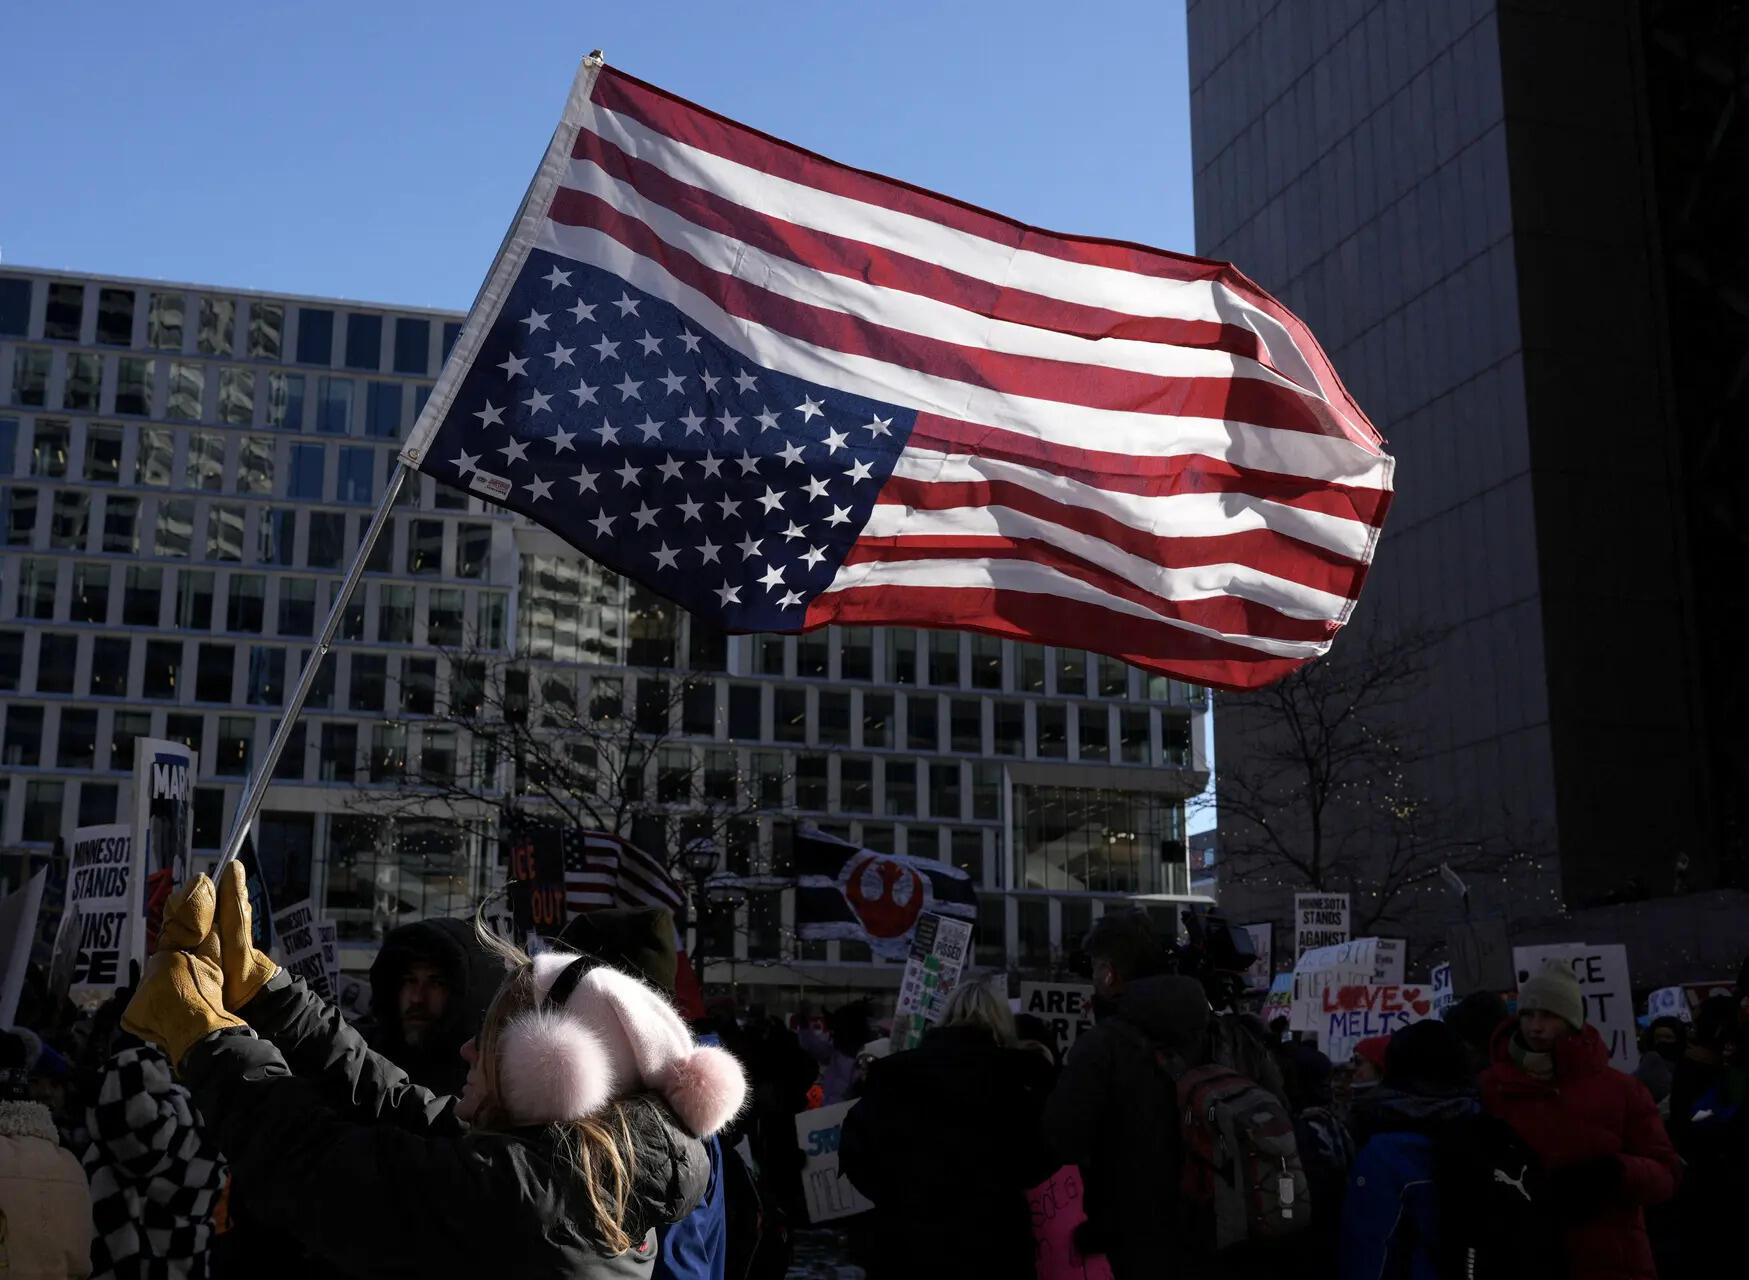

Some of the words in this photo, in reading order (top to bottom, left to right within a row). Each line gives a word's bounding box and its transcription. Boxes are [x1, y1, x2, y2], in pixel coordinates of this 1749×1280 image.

[73, 837, 131, 868] MINNESOT
[72, 867, 129, 900] STANDS
[531, 888, 563, 925] OUT
[1303, 911, 1342, 925] STANDS
[79, 911, 127, 949] INST
[1299, 931, 1347, 946] AGAINST
[71, 950, 119, 984] CE
[1028, 990, 1081, 1013] ARE
